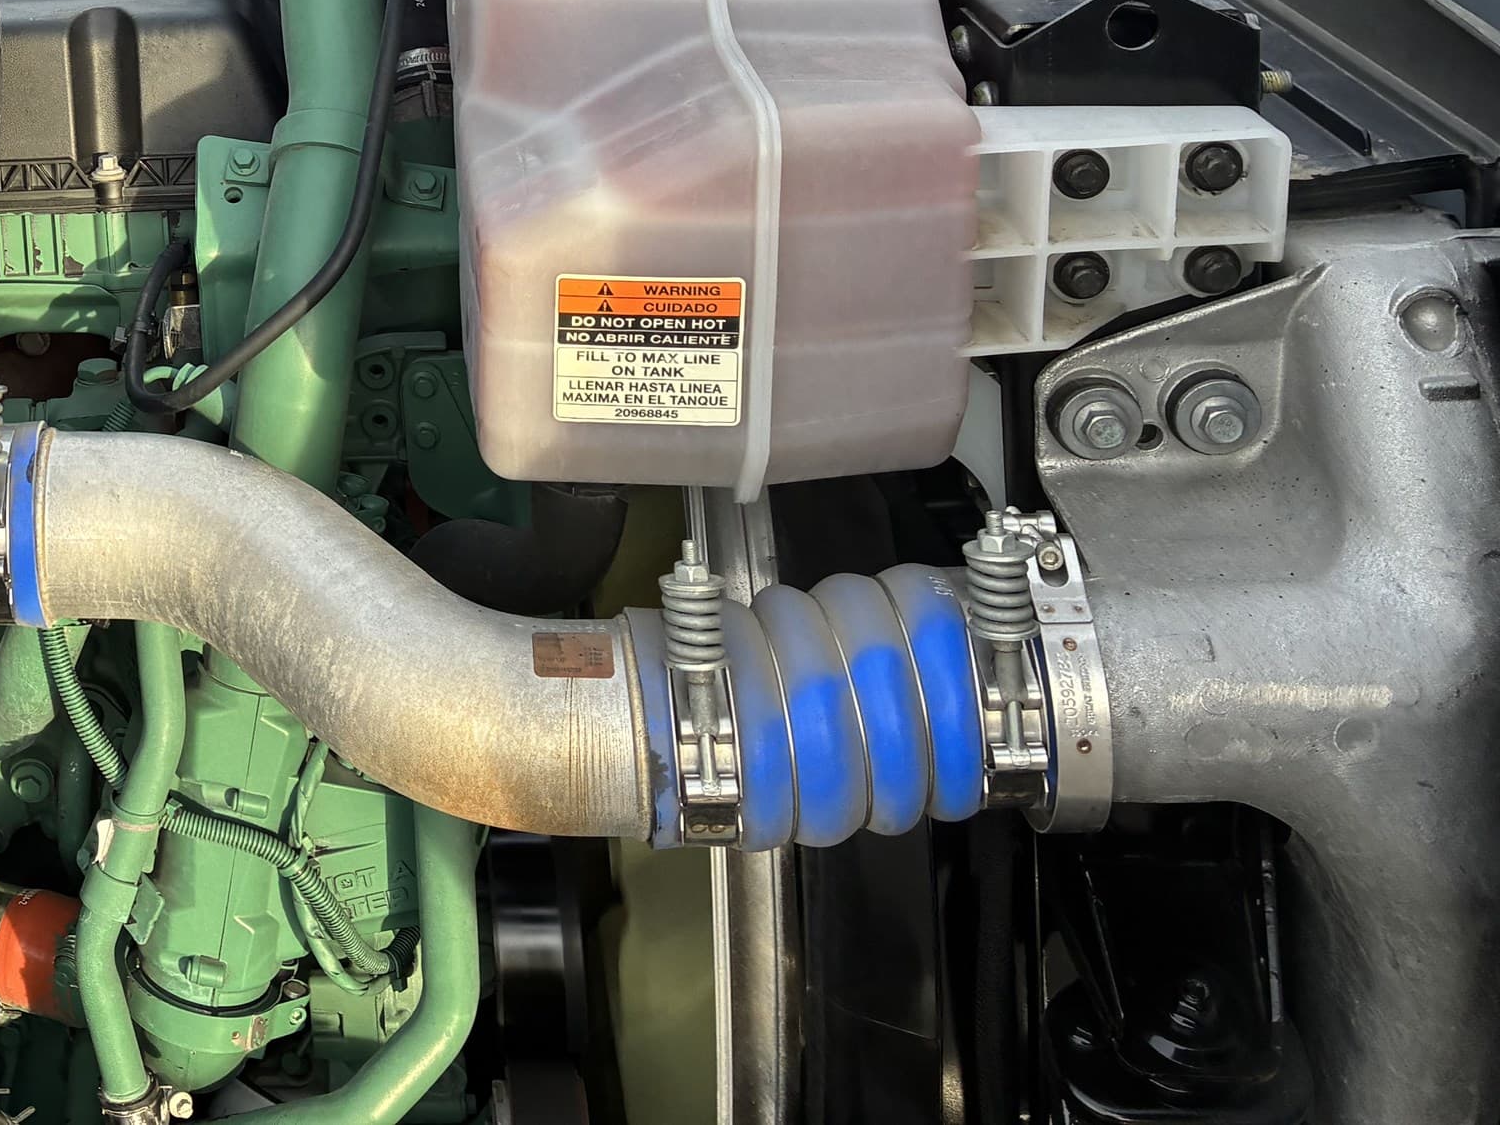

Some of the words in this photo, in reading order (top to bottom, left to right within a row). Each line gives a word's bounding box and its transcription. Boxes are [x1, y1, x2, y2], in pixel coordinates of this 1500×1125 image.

[644, 285, 721, 296] WARNING
[643, 302, 718, 313] CUIDADO
[572, 317, 595, 327] DO
[601, 318, 635, 328] NOT
[640, 318, 685, 329] OPEN
[692, 319, 726, 330] HOT
[566, 332, 590, 342] NO
[595, 333, 644, 344] ABRIR
[650, 334, 731, 345] CALIENTE
[577, 351, 609, 362] FILL
[616, 351, 636, 363] TO
[642, 353, 679, 364] MAX
[684, 354, 721, 365] LINE
[612, 366, 635, 376] ON
[641, 366, 685, 377] TANK
[569, 380, 624, 392] LLENAR
[629, 382, 676, 393] HASTA
[680, 383, 722, 394] LINEA
[563, 393, 619, 403] MAXIMA
[624, 394, 643, 404] EN
[649, 395, 666, 405] EL
[670, 395, 728, 406] TANQUE
[615, 408, 679, 418] 20968845
